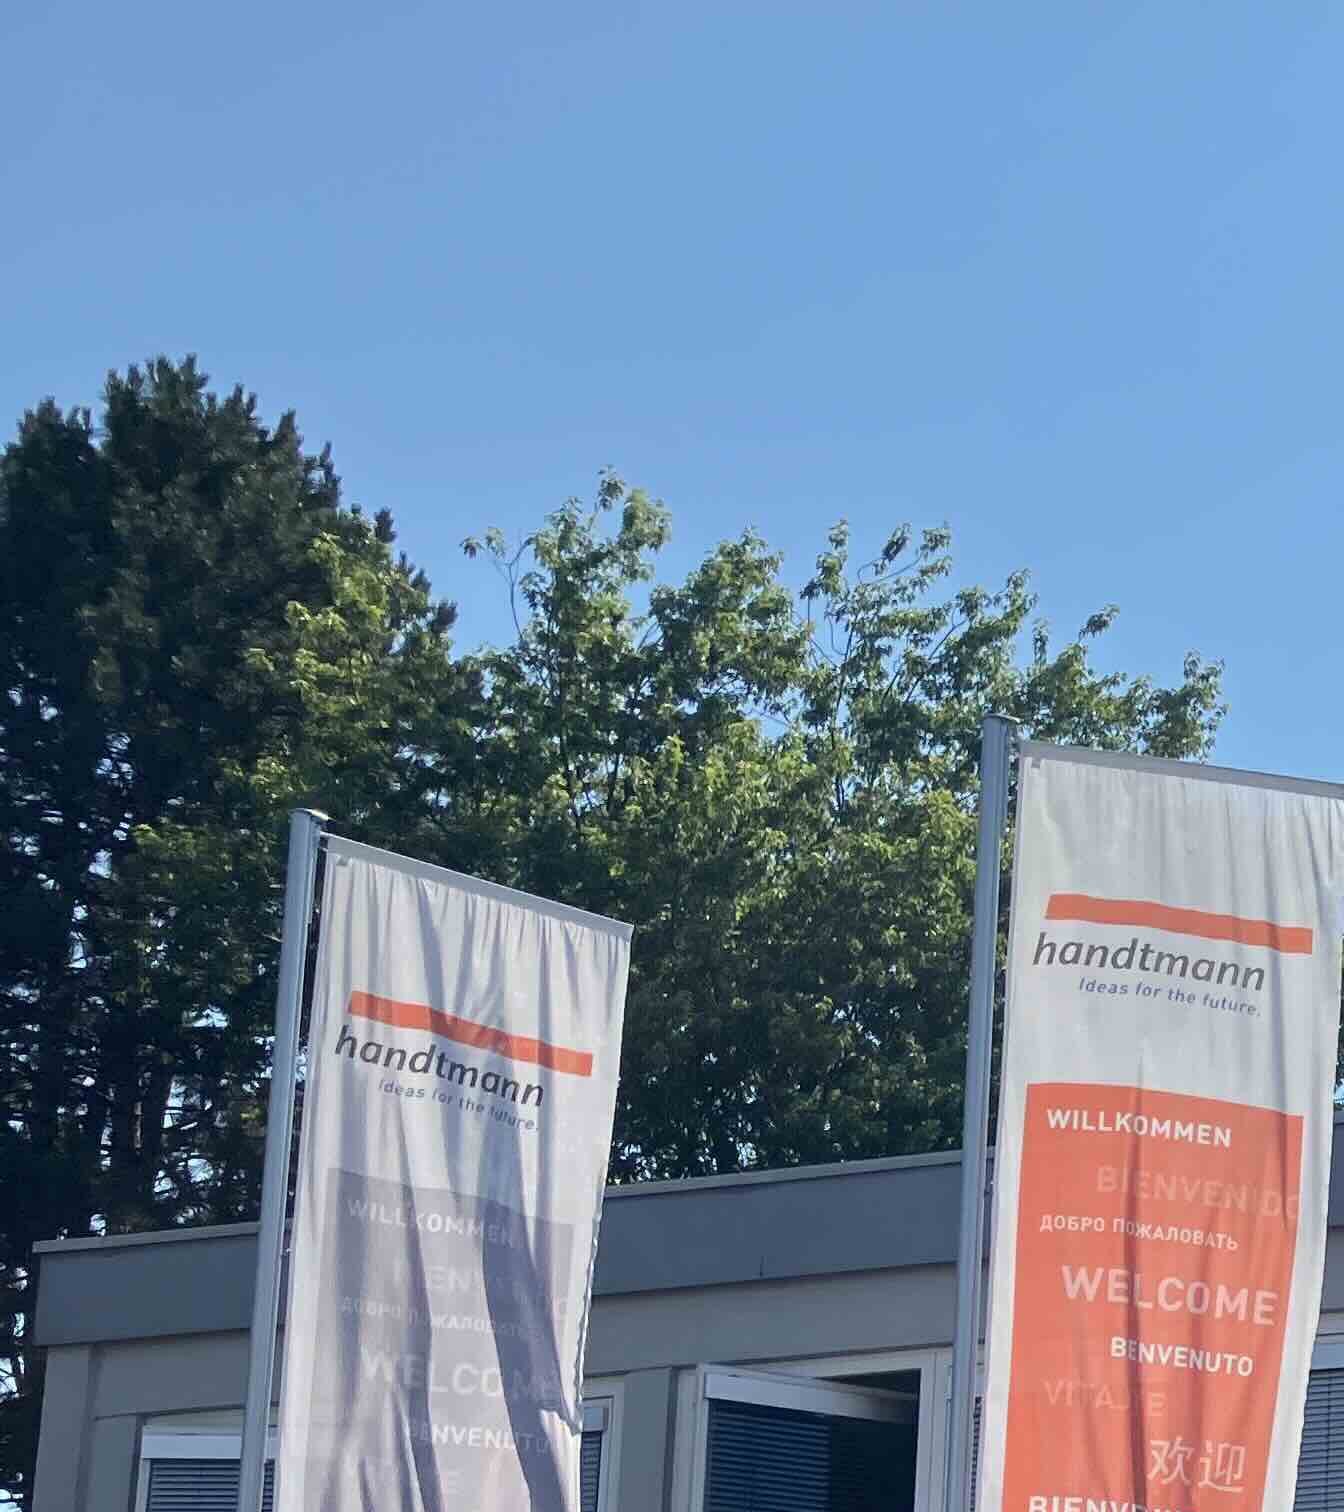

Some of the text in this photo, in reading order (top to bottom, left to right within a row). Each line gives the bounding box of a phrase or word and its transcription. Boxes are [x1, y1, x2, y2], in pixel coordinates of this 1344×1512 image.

[1032, 931, 1265, 992] handtmann
[1079, 976, 1262, 1018] Ideas for the future.
[335, 1023, 544, 1108] handtmann
[378, 1079, 426, 1099] Ideas
[432, 1089, 453, 1106] for
[458, 1097, 485, 1113] the
[1047, 1108, 1232, 1148] WILLKOMMEN
[1039, 1214, 1239, 1251] ДОБРО ПОЖАЛОВАТЬ
[1061, 1263, 1279, 1327] WELCOME
[1110, 1335, 1255, 1378] BENVENUTO
[1147, 1435, 1247, 1494] 欢迎
